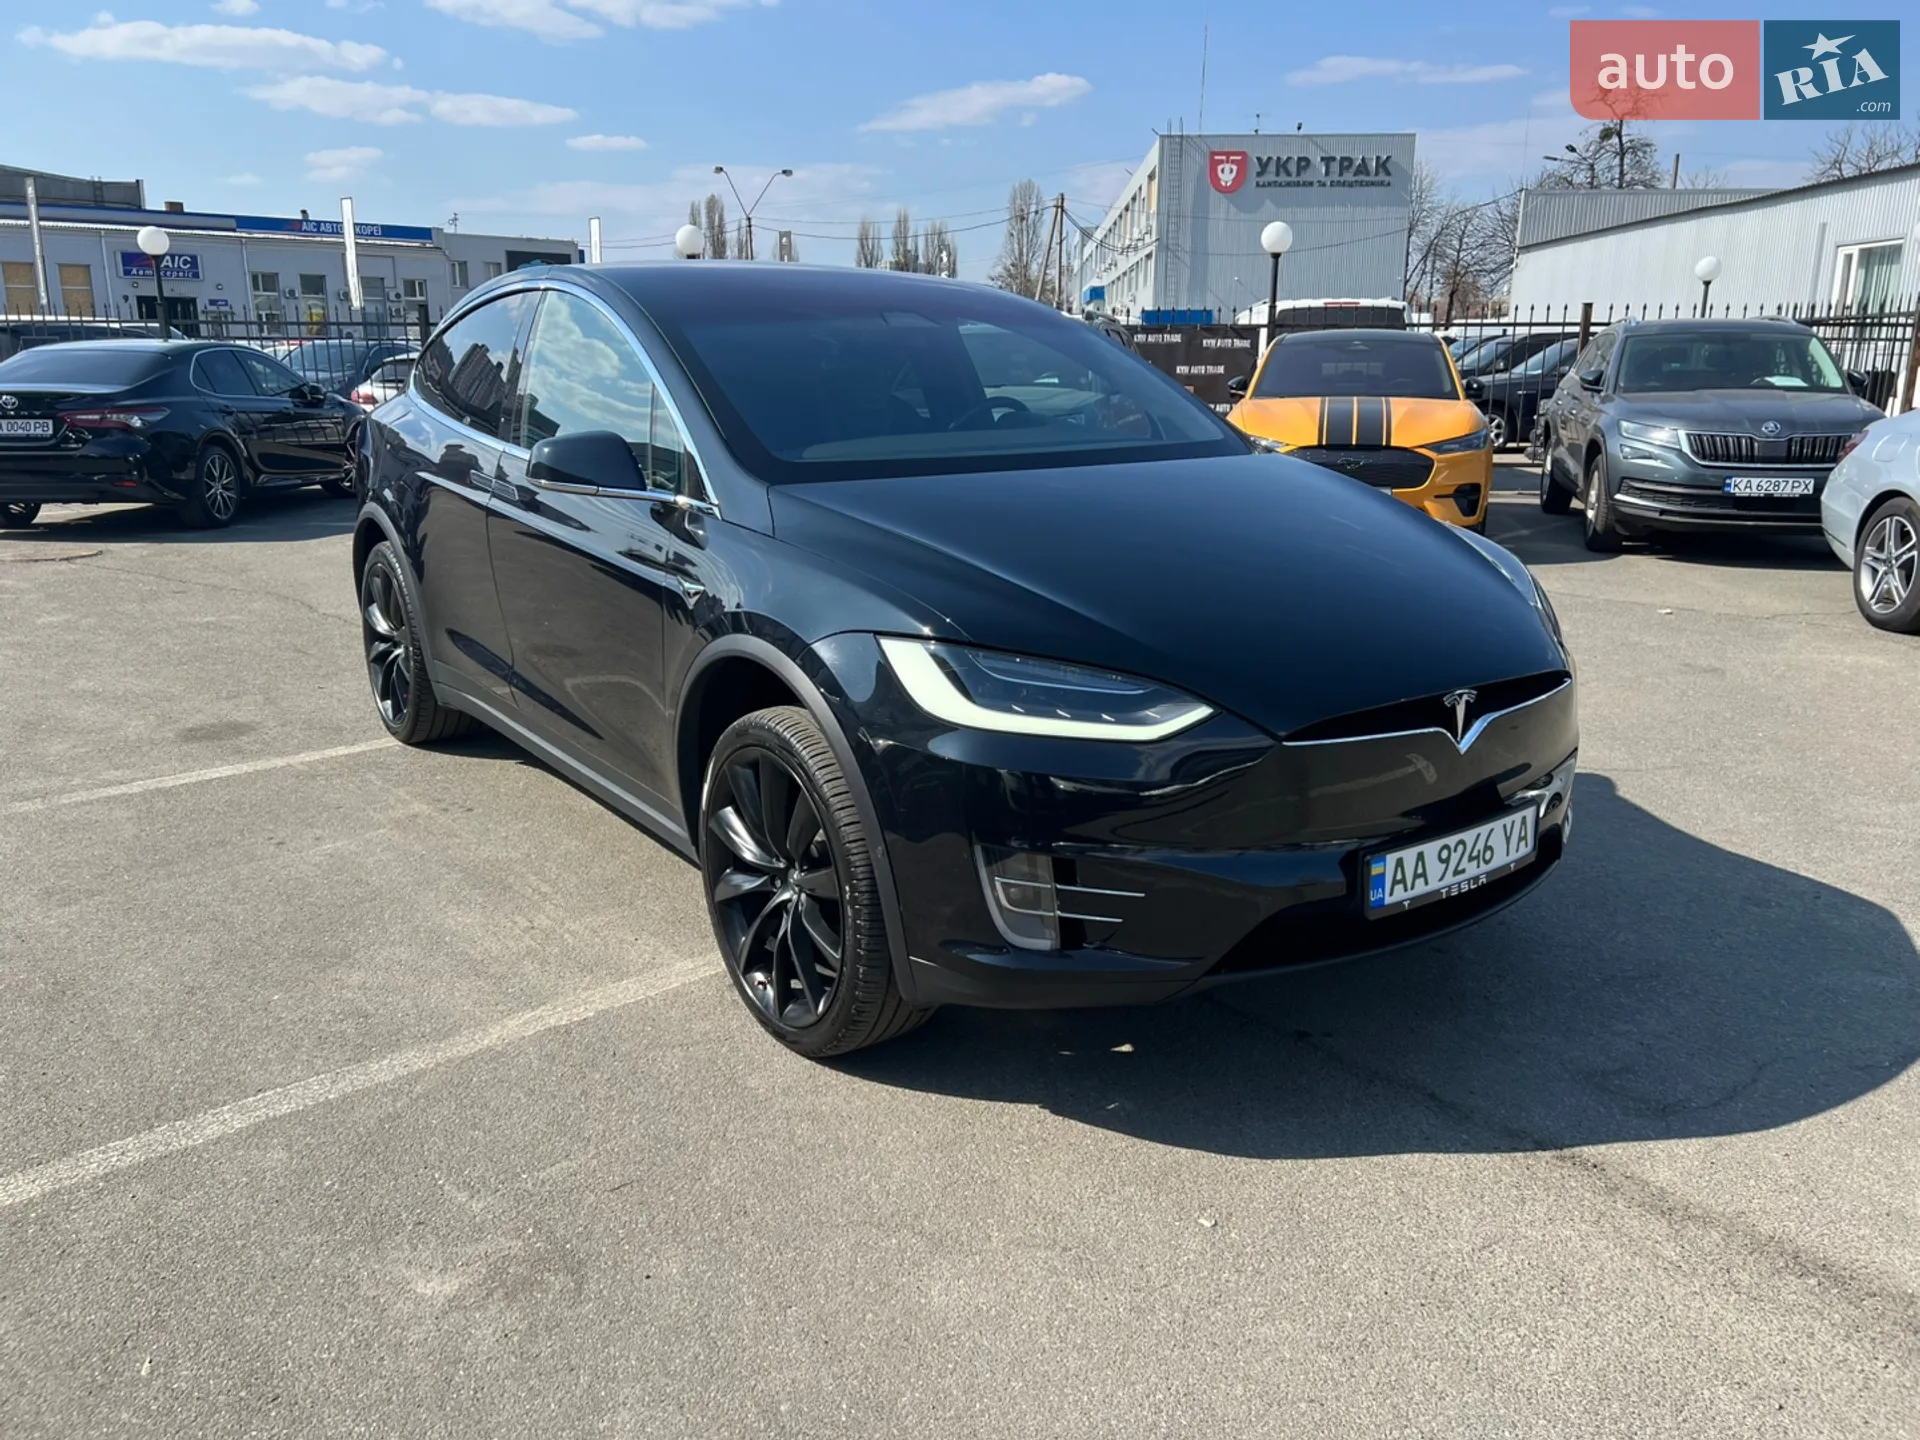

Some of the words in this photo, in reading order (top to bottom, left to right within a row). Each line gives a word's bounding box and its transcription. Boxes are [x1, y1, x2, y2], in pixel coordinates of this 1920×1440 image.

[1255, 155, 1312, 178] УКР
[1319, 154, 1392, 177] ТРАК
[1147, 333, 1162, 343] AUTO
[1163, 333, 1182, 343] TRADE
[1216, 338, 1232, 348] AUTO
[1190, 365, 1205, 374] AUTO
[1206, 364, 1225, 374] TRADE
[6, 421, 32, 432] 0040
[33, 421, 50, 432] PB
[1733, 479, 1753, 492] KA
[1756, 479, 1790, 492] 6287
[1790, 480, 1812, 493] PX
[1389, 850, 1429, 898] AA
[1437, 827, 1495, 883] 9246
[1502, 814, 1529, 857] YA
[1440, 874, 1487, 899] TESLA
[1370, 889, 1384, 901] UA
